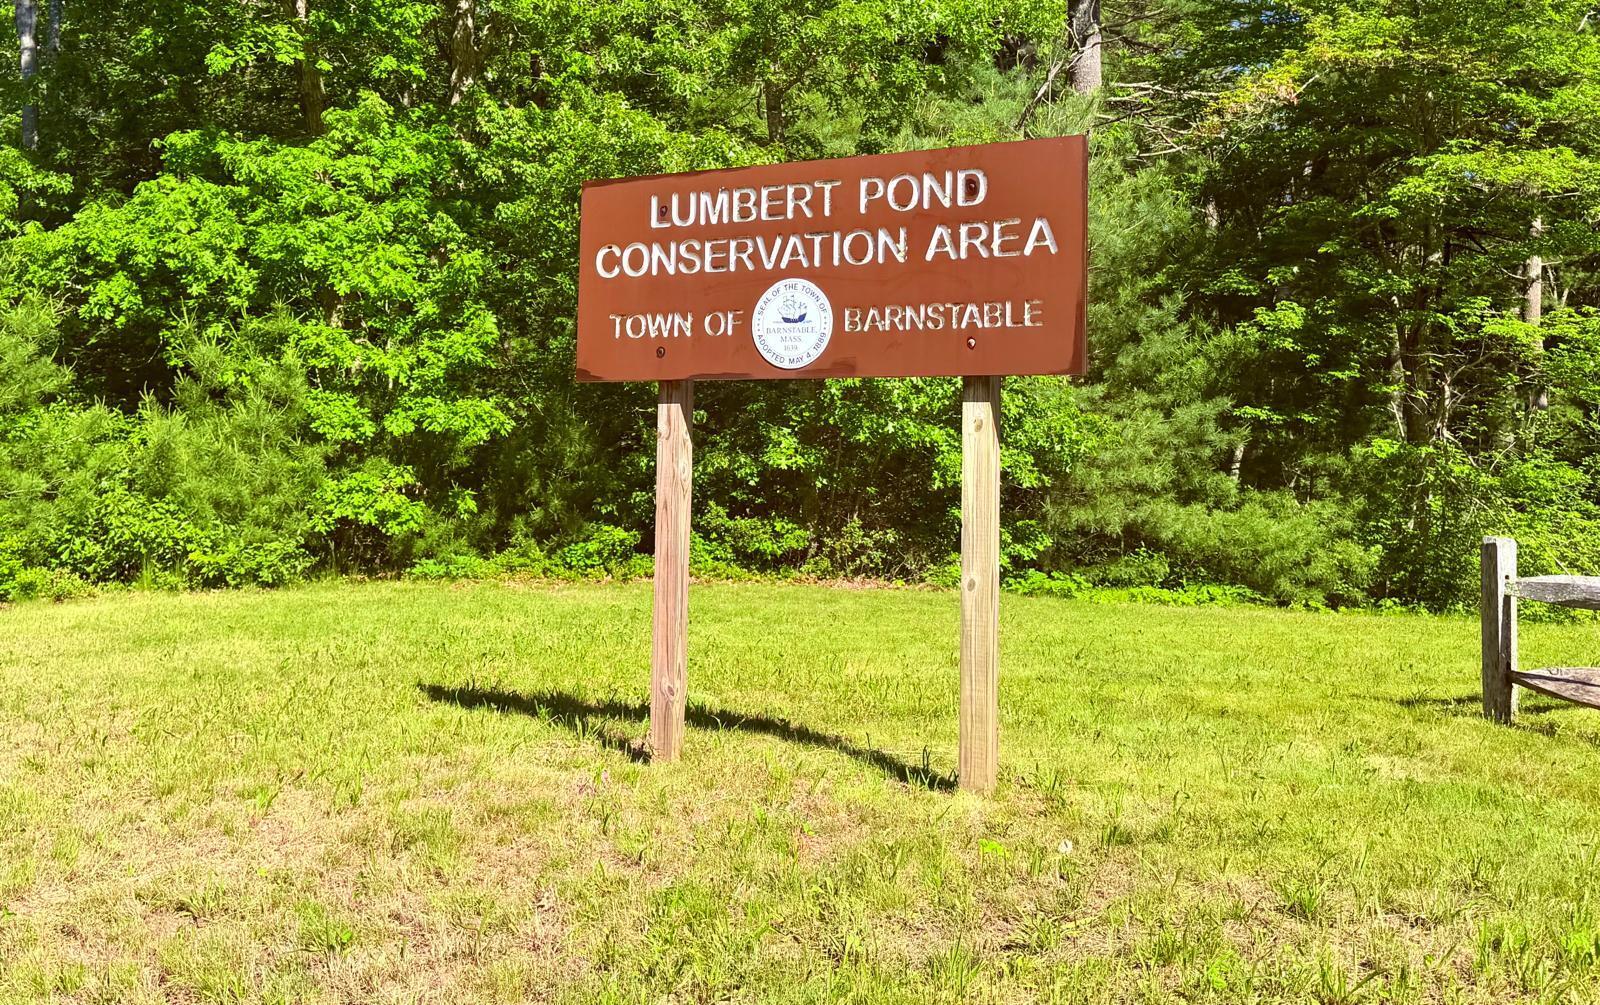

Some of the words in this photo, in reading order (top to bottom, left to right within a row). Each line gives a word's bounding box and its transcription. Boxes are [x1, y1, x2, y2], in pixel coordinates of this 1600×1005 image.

[650, 179, 842, 228] LUMBERT
[860, 168, 988, 214] POND
[595, 226, 908, 278] CONSERVATION
[925, 217, 1058, 261] AREA
[609, 311, 693, 339] TOWN
[705, 310, 744, 336] OF
[844, 300, 1044, 332] BARNSTABLE
[758, 297, 772, 316] SEAL
[772, 287, 781, 296] OF
[801, 286, 820, 302] TOWN
[819, 303, 827, 313] OF
[758, 334, 785, 363] ADOPTED
[789, 356, 804, 364] MAY
[814, 333, 826, 351] 1889
